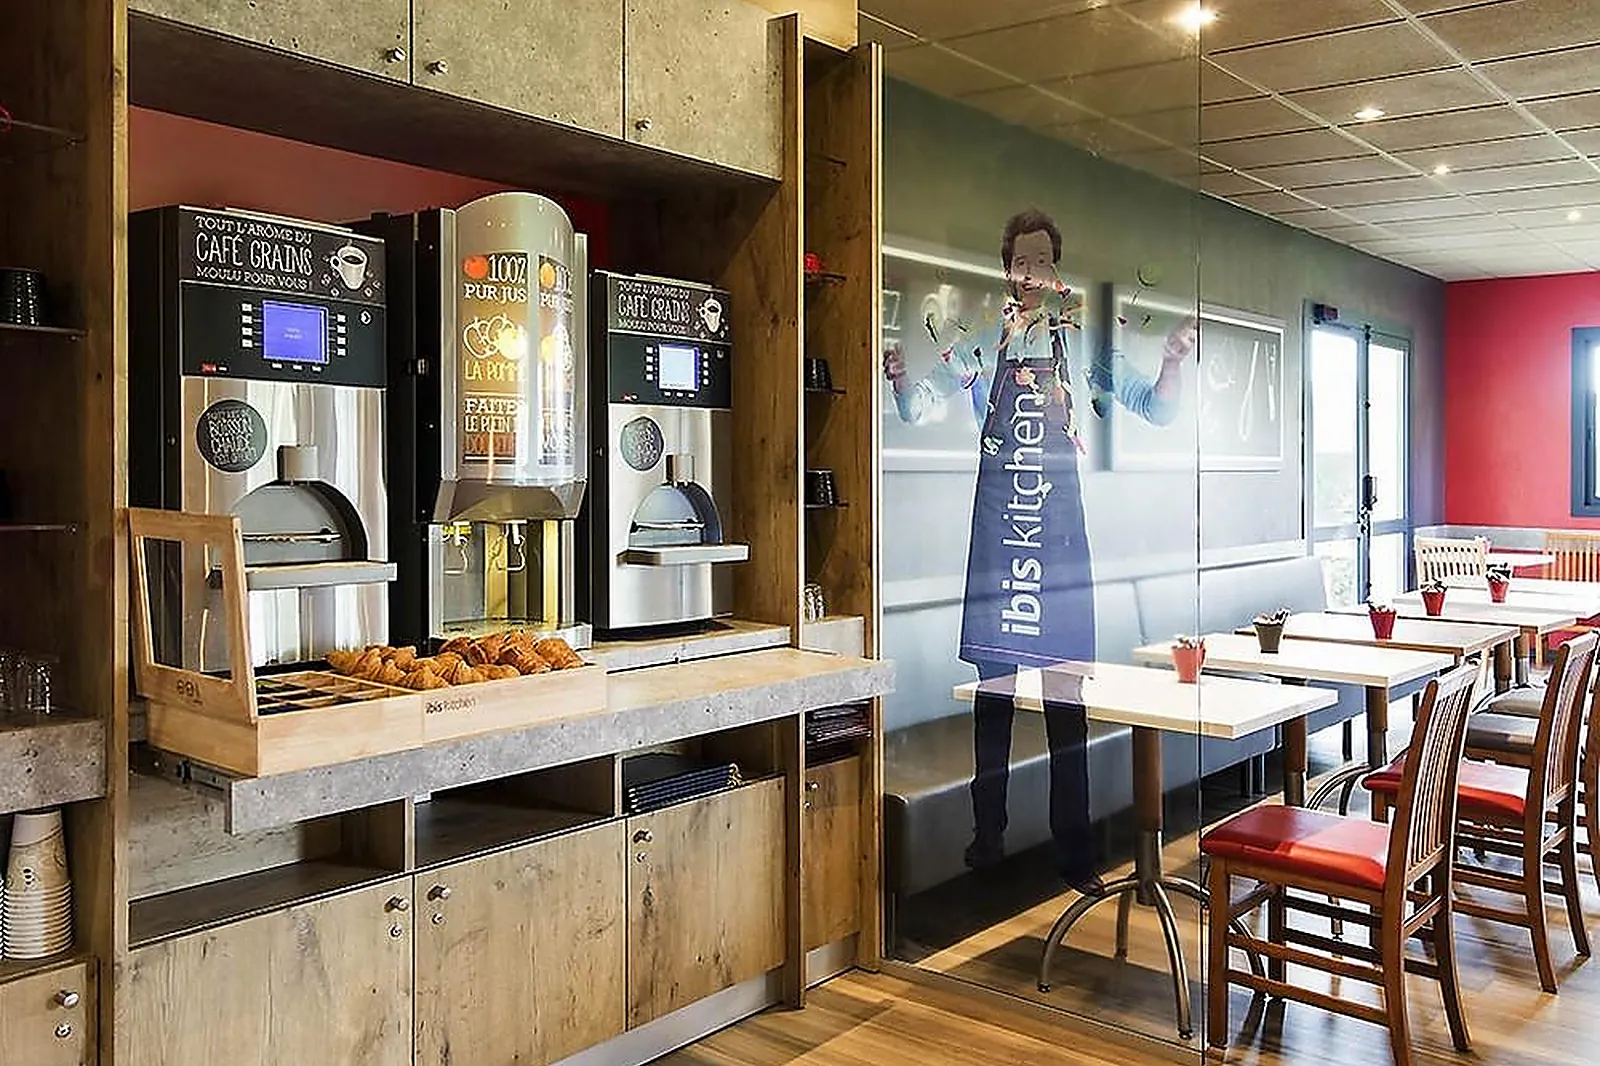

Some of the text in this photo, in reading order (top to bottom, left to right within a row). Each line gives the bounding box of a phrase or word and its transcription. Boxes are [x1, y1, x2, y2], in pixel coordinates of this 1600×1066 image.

[195, 215, 234, 232] TOUT
[295, 231, 312, 244] DU
[196, 232, 312, 276] CAFÉ GRAINS
[196, 265, 241, 281] MOULU
[244, 272, 276, 286] POUR
[488, 254, 526, 284] 100%
[464, 282, 527, 305] PUR JUS
[465, 359, 483, 381] LA
[1001, 391, 1047, 637] ibis kitchen
